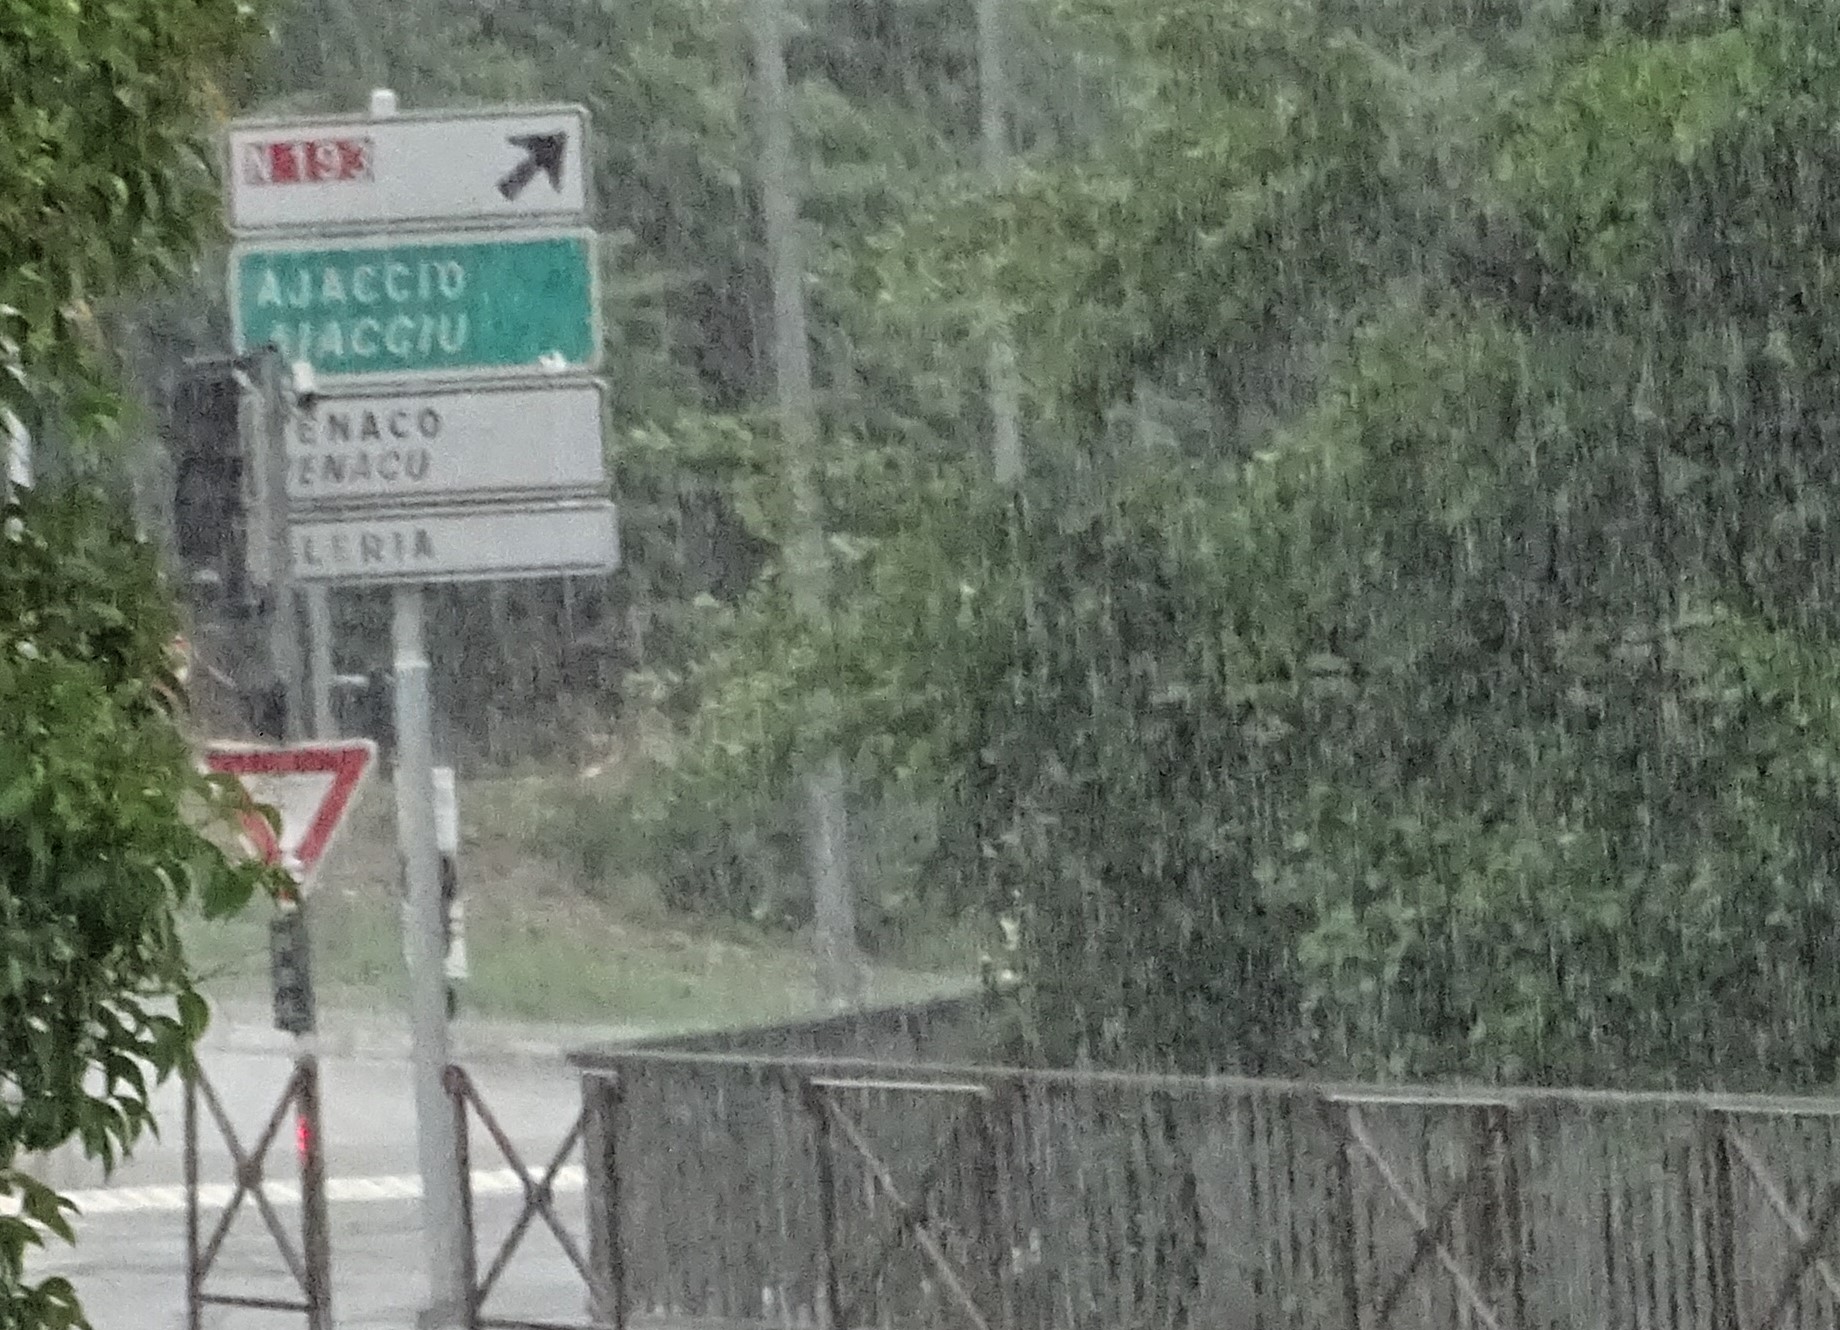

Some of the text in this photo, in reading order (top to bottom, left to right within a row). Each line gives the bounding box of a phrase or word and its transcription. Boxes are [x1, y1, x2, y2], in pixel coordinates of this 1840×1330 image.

[257, 259, 467, 308] AJACCIO
[297, 407, 442, 446] ENACO
[299, 450, 431, 486] ENACU
[302, 528, 434, 566] LERIA
